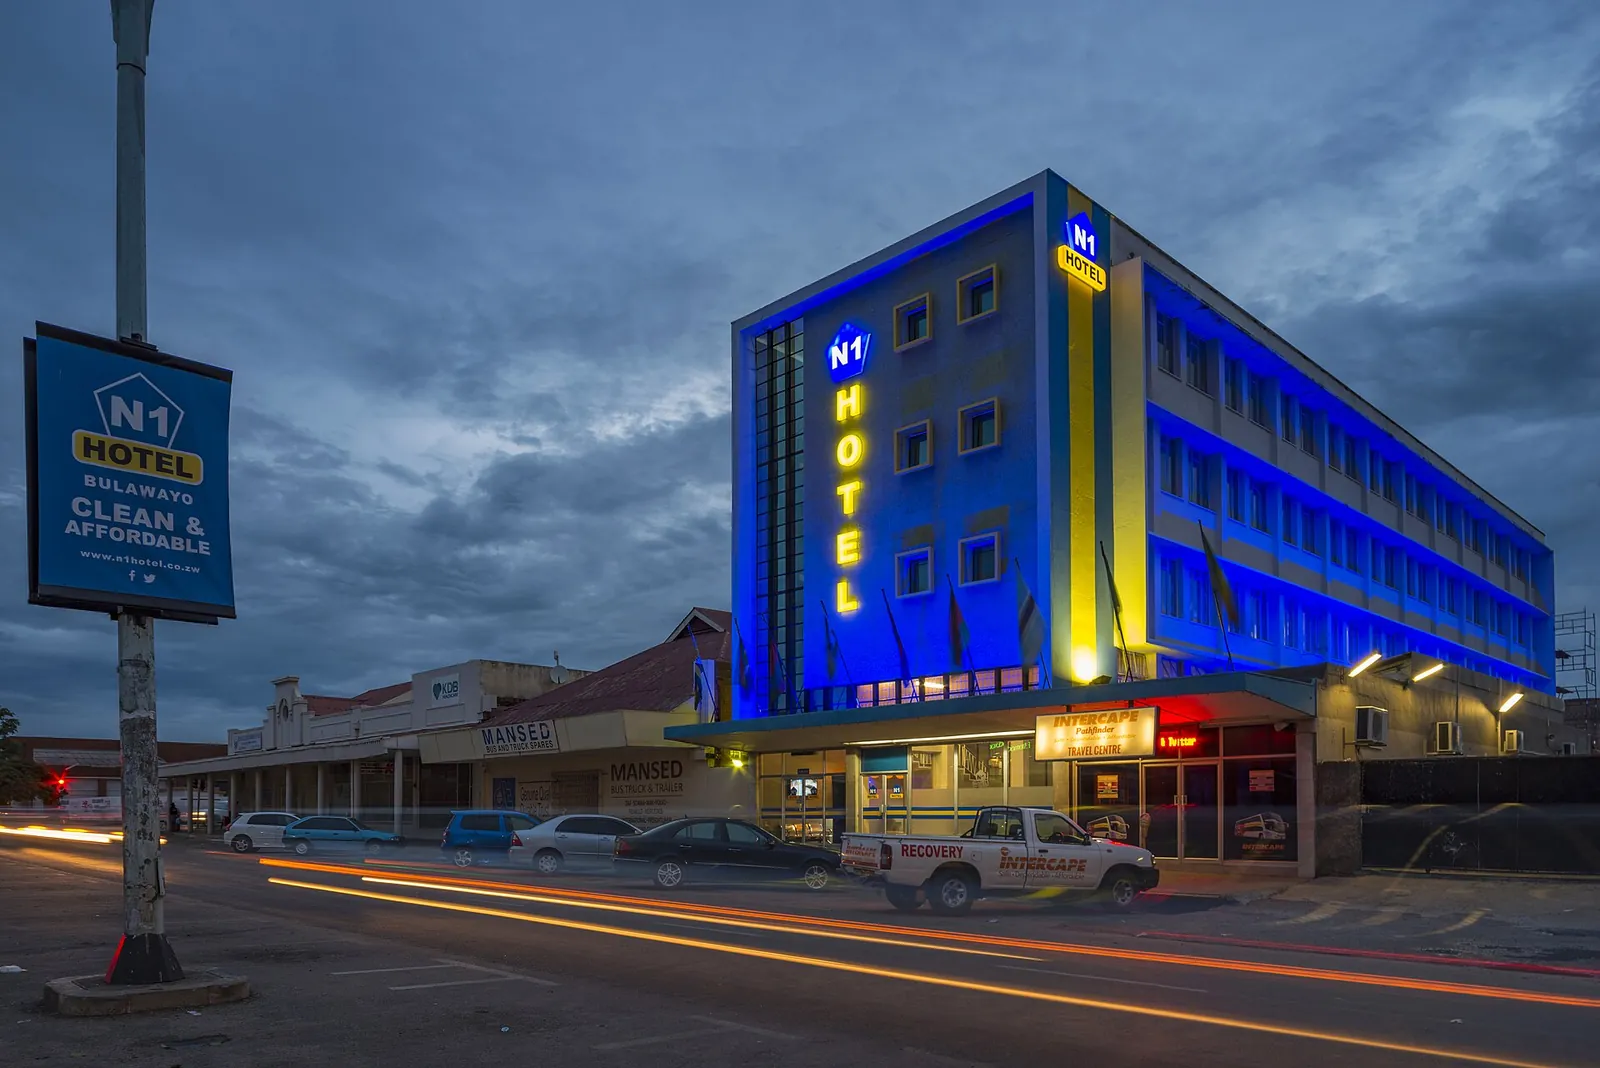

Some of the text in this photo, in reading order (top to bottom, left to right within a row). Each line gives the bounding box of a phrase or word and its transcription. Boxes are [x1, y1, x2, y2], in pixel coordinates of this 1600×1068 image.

[1074, 223, 1095, 257] N1
[1065, 250, 1103, 285] HOTEL
[831, 335, 863, 369] N1
[111, 395, 168, 438] N1
[83, 436, 193, 479] HOTEL
[84, 474, 193, 505] BULAWAYO
[836, 383, 863, 615] HOTEL
[71, 496, 205, 537] CLEAN &
[65, 519, 211, 556] AFFORDABLE
[80, 550, 200, 574] www.n1hotel.co.zw
[442, 680, 459, 694] KDB
[1053, 711, 1139, 727] INTERCAPE
[482, 722, 550, 745] MANSED
[1076, 726, 1116, 736] Pathfinder
[486, 740, 554, 753] BUS AND TRUCK SPARES
[1067, 744, 1121, 757] TRAVEL CENTRE
[611, 760, 683, 781] MANSED
[625, 784, 646, 794] TRUCK
[647, 784, 653, 793] &
[655, 782, 683, 793] TRAILER
[901, 844, 964, 859] RECOVERY
[999, 856, 1088, 872] INTERCAPE
